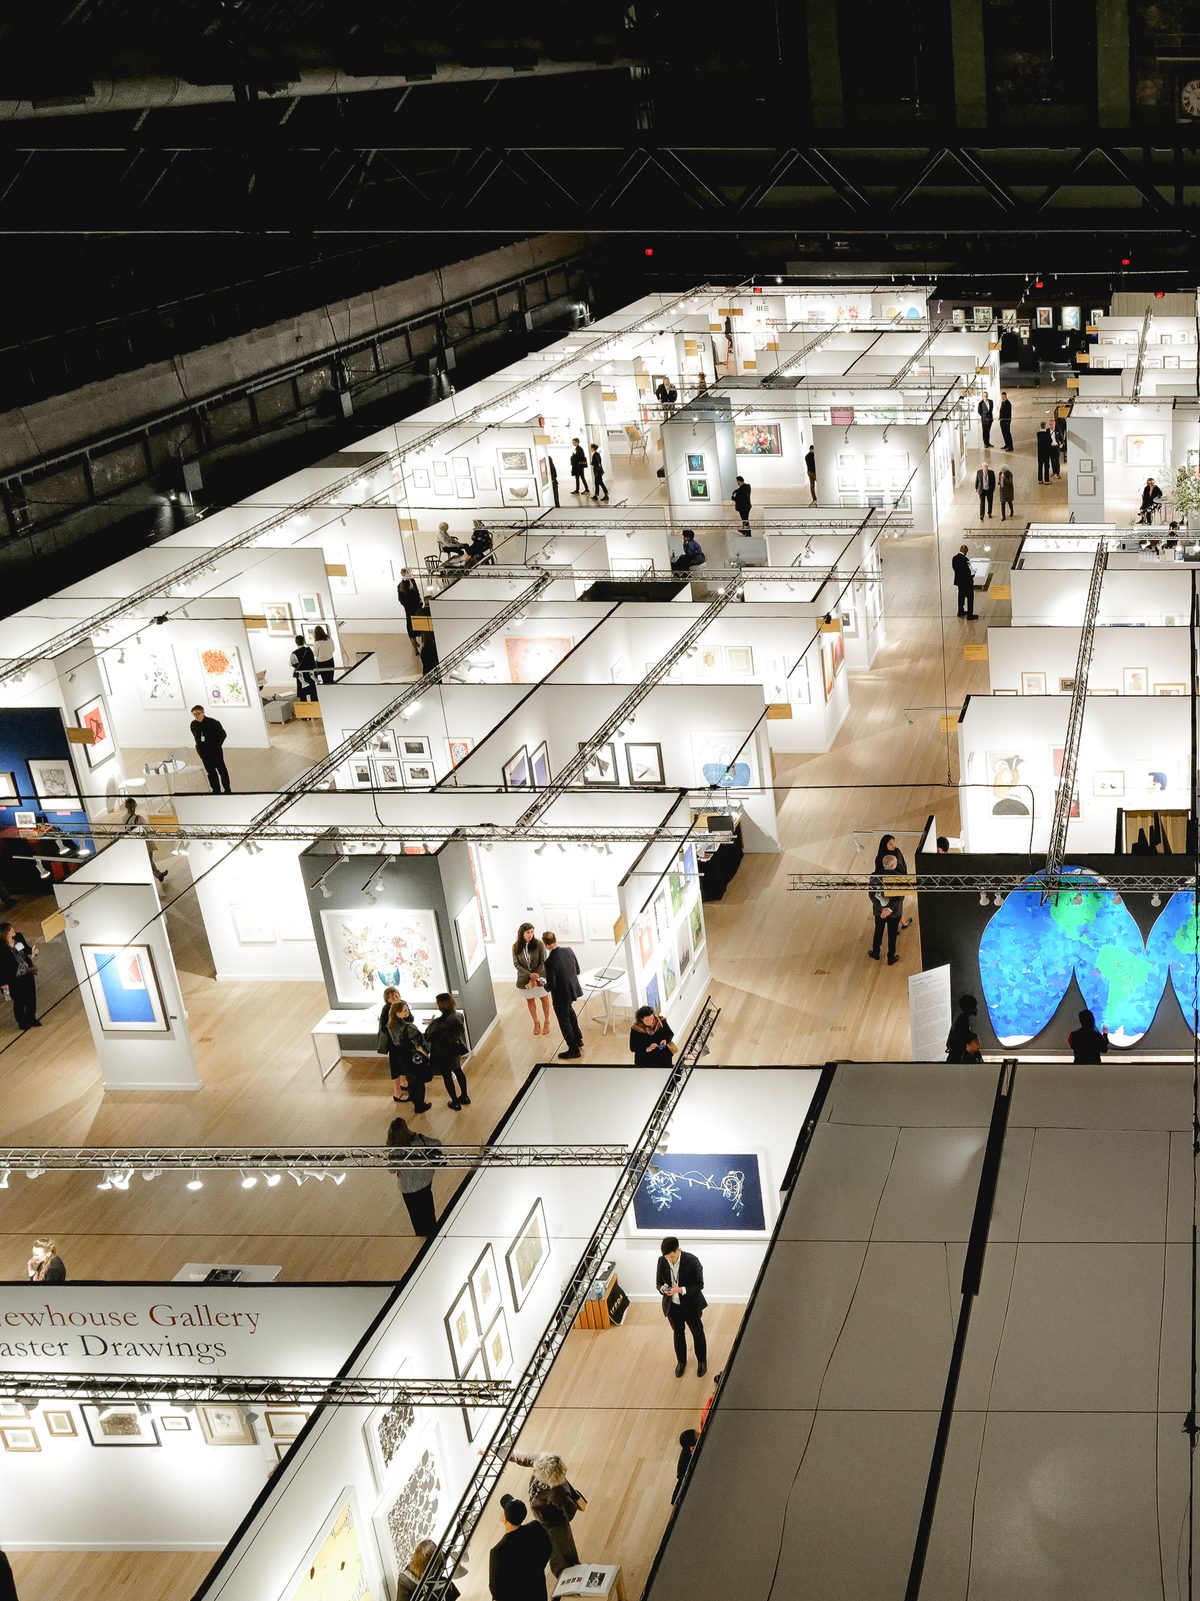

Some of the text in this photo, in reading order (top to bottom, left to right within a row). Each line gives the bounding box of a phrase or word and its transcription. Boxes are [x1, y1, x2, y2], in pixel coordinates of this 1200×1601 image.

[0, 1304, 261, 1334] ewhouse Gallery
[0, 1334, 228, 1365] aster Drawings
